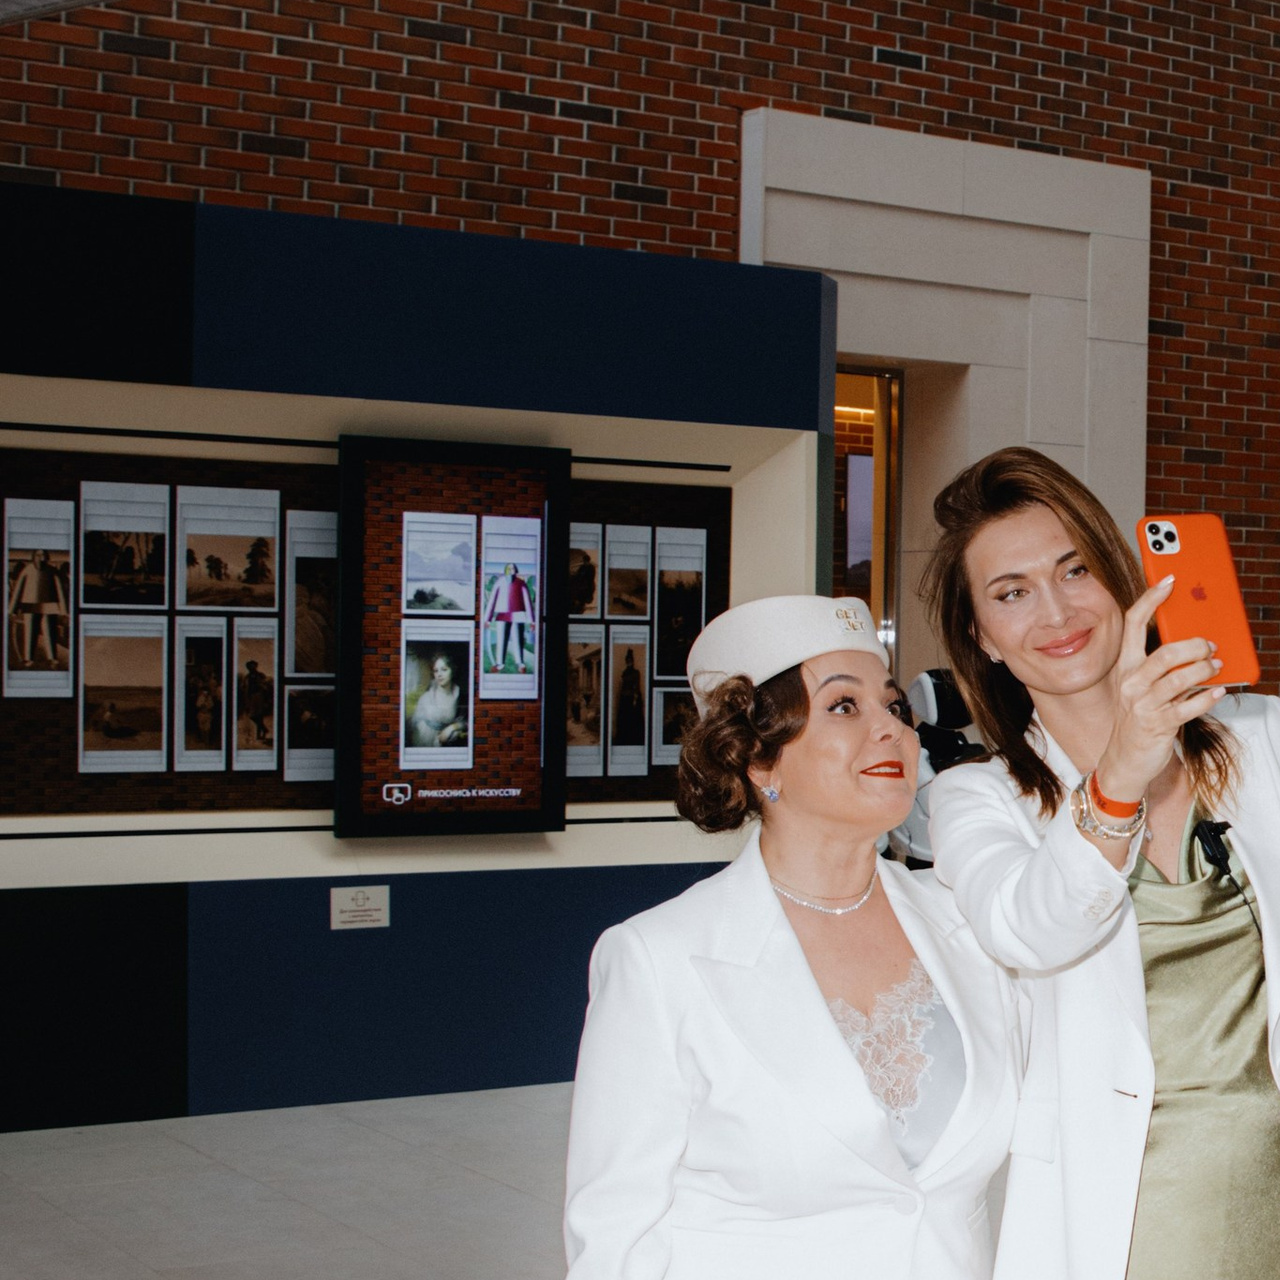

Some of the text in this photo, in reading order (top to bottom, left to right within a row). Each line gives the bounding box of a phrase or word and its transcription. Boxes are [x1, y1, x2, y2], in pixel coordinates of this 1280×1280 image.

[836, 608, 857, 620] GET
[845, 620, 865, 631] JET
[418, 789, 471, 797] ПРИКОСНИСЬ
[478, 788, 521, 796] ИСКУССТВУ
